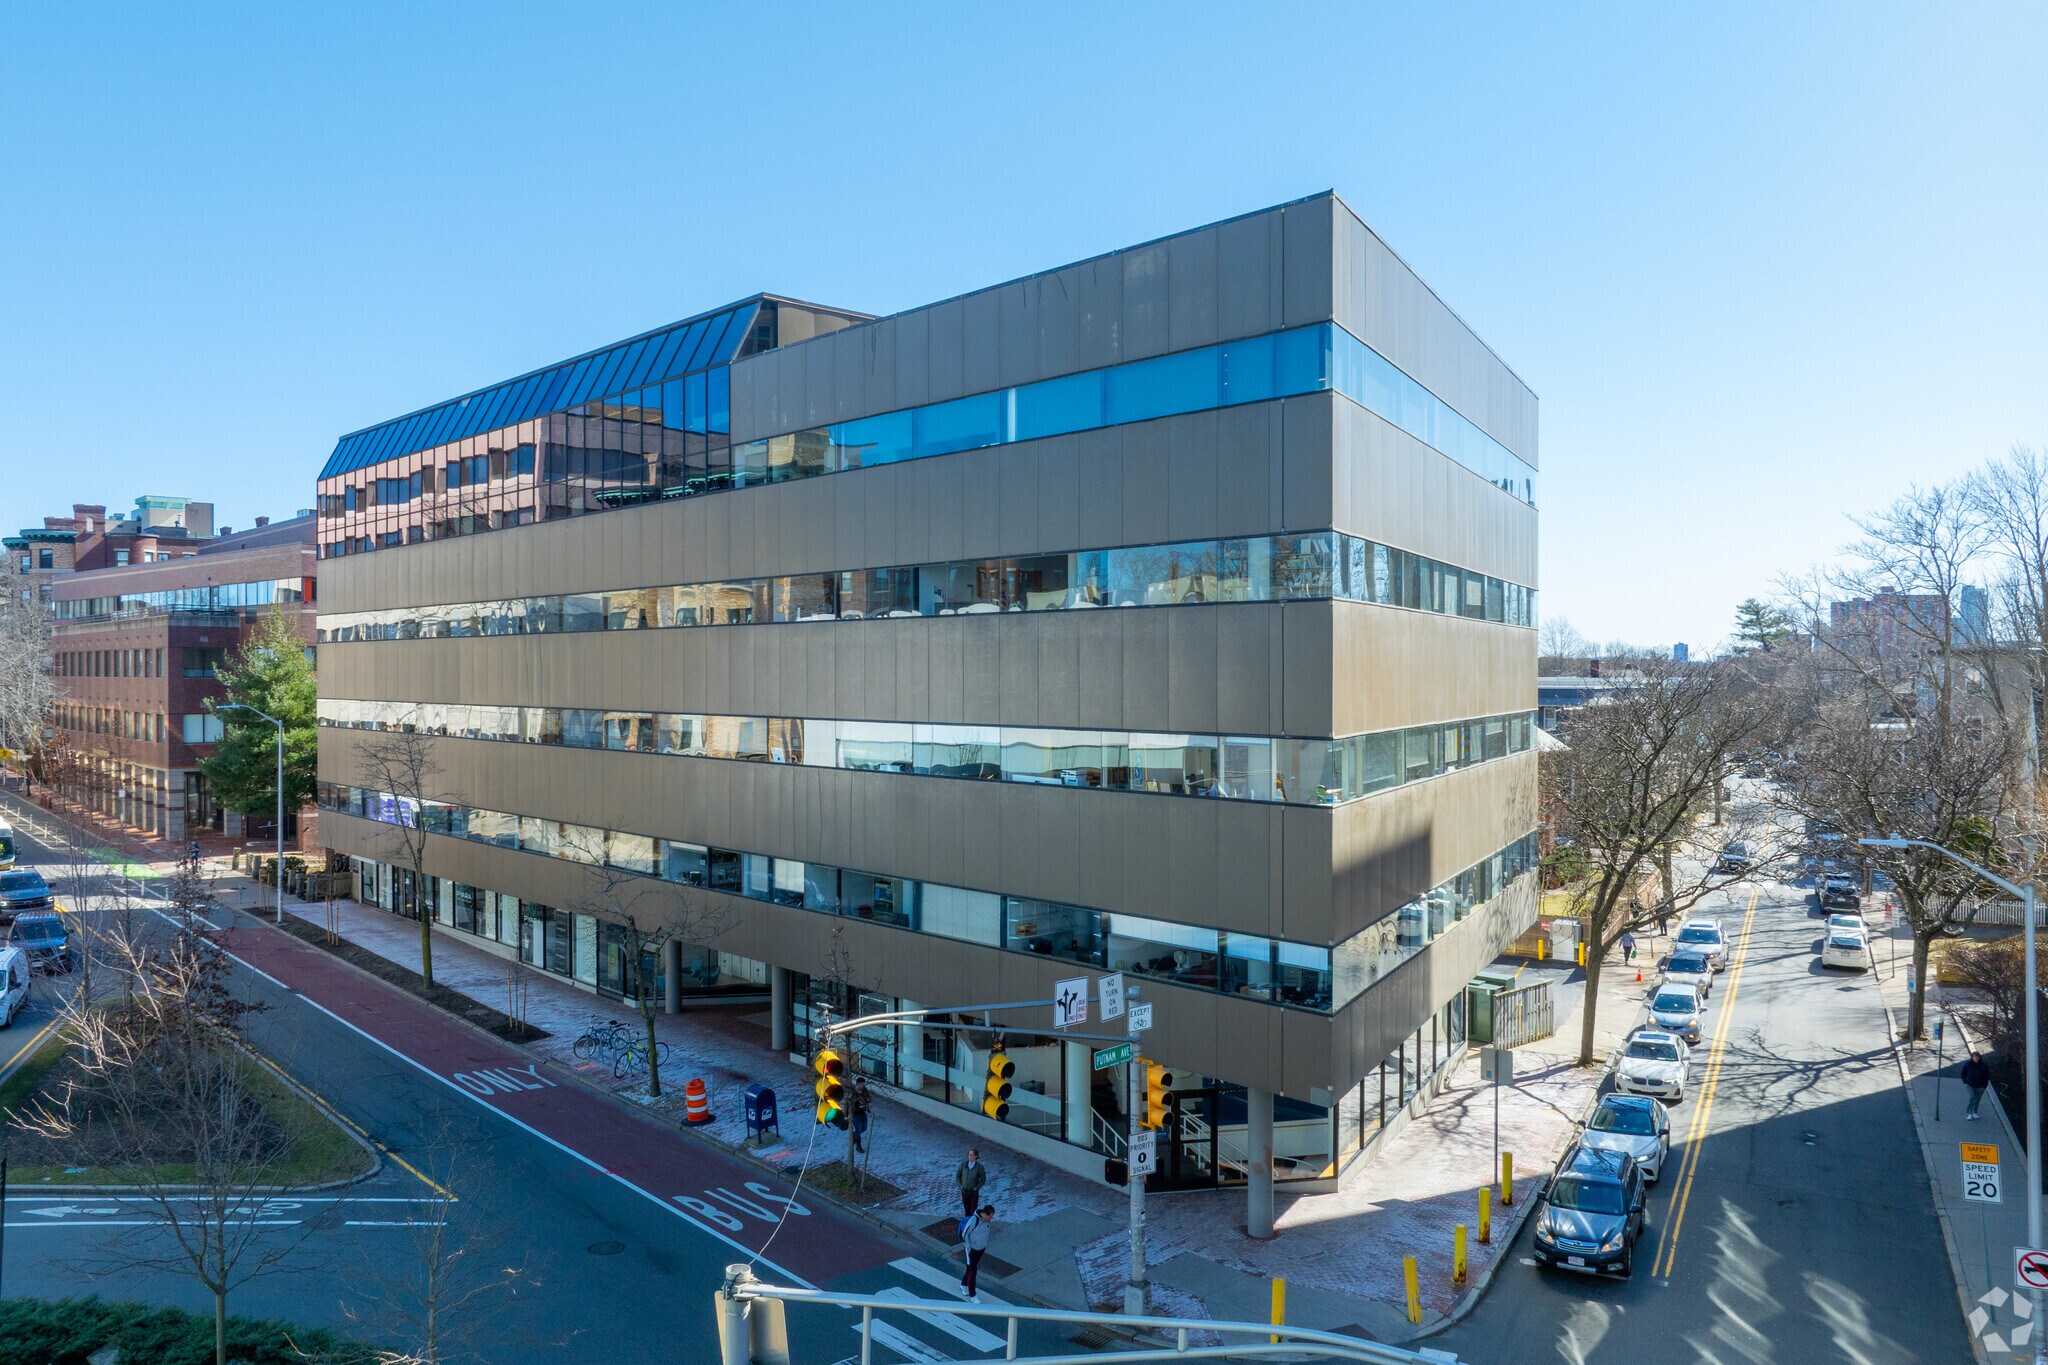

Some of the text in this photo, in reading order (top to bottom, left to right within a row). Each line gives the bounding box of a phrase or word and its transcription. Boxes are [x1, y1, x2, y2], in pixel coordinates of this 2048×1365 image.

[1107, 979, 1115, 987] NO
[1105, 988, 1118, 997] TURN
[1108, 1007, 1118, 1016] RED
[1130, 1007, 1150, 1018] EXCEPT
[1096, 1046, 1130, 1066] PUTNAM AVE
[454, 1065, 557, 1095] ONLY
[1137, 1134, 1148, 1142] BUS
[1130, 1142, 1154, 1152] PRIORITY
[1133, 1164, 1152, 1174] SIGNAL
[1965, 1164, 1997, 1173] SPEED
[1967, 1181, 1997, 1198] 20
[672, 1182, 812, 1232] BUS
